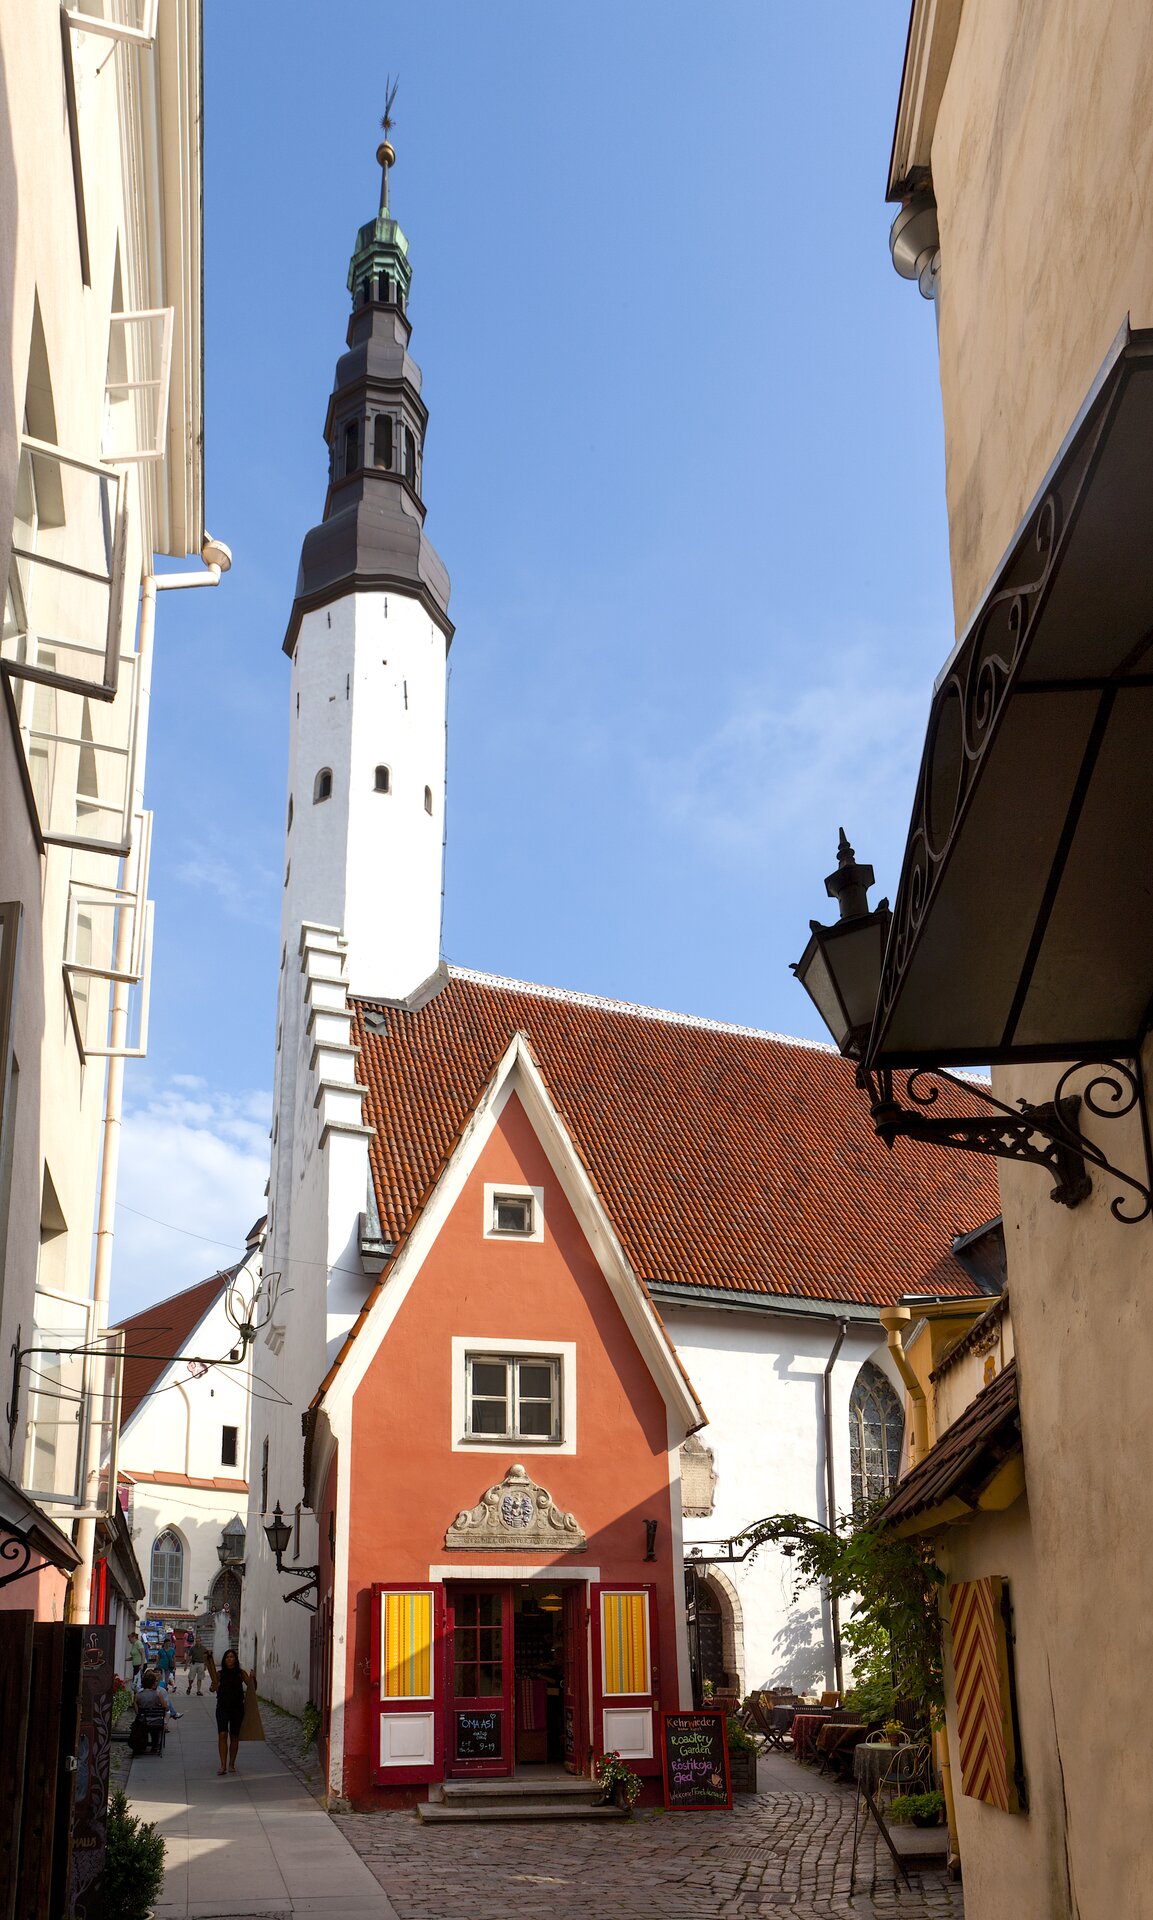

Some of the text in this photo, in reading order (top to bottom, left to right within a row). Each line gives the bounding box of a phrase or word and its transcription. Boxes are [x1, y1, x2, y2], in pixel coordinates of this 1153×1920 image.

[666, 1716, 716, 1728] Kehrwieder
[671, 1732, 713, 1748] Roastery
[680, 1743, 711, 1756] Garden
